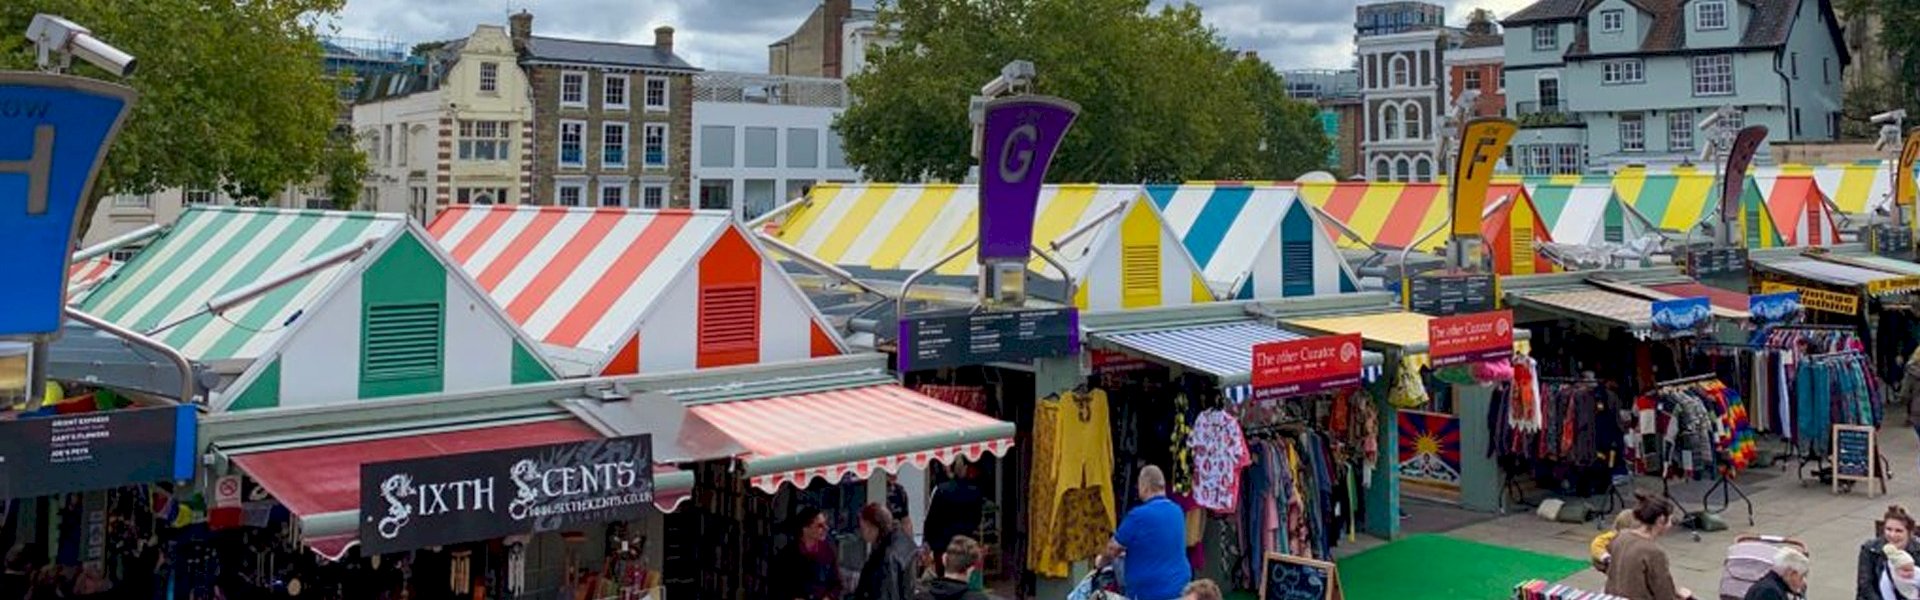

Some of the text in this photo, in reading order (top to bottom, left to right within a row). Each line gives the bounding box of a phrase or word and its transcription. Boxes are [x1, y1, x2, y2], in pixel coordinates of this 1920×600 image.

[0, 99, 49, 118] OW
[999, 123, 1037, 183] G
[1467, 138, 1495, 180] F
[1801, 298, 1854, 313] lothing
[1257, 346, 1336, 366] The other Curator
